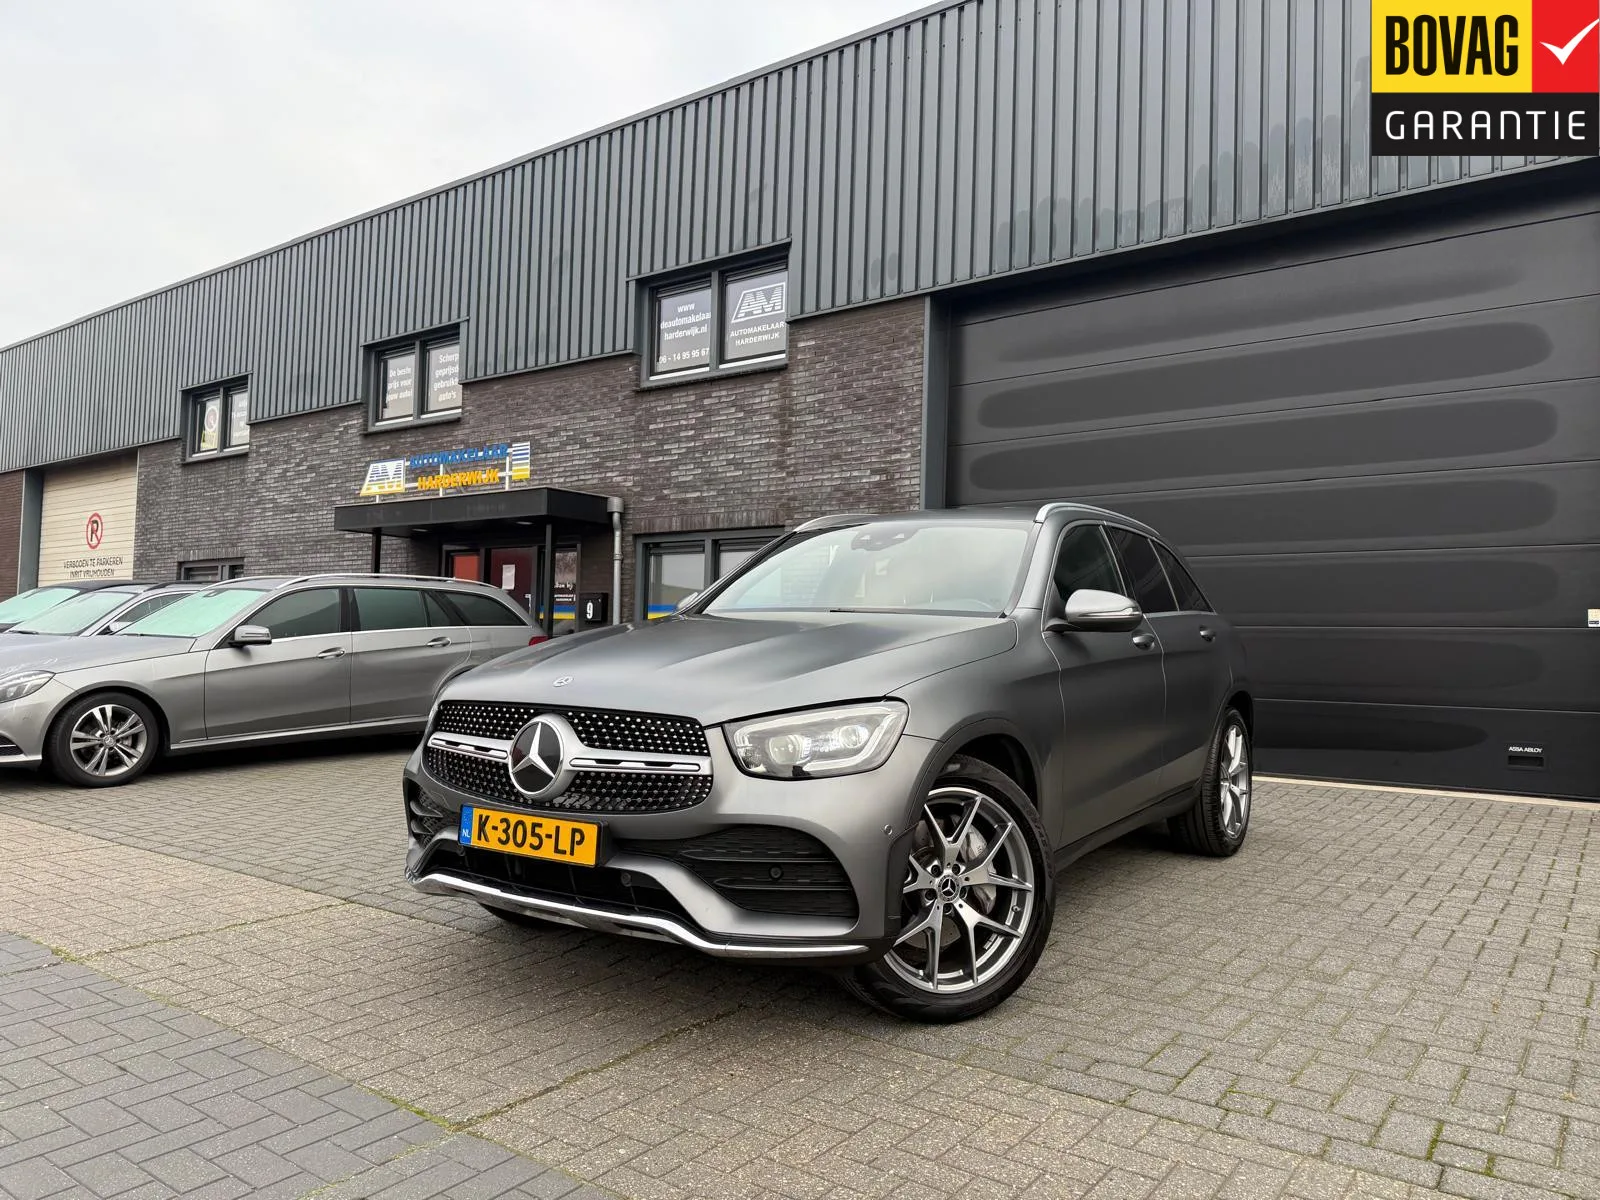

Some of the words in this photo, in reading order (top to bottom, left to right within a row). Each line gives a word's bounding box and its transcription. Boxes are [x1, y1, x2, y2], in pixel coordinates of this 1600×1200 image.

[664, 324, 708, 341] harderwijk.nl
[730, 321, 785, 338] AUTOMAKELAAR
[735, 332, 780, 347] HARDERWIJK
[673, 353, 681, 362] 14
[691, 349, 700, 358] 95
[409, 443, 509, 469] AUTOMAKELAAR
[417, 468, 500, 491] HARDERWIJK
[64, 559, 89, 569] VERBODEN
[90, 558, 96, 567] TE
[97, 556, 123, 567] PARKEREN
[586, 602, 594, 619] 9
[462, 829, 470, 838] NL
[477, 813, 586, 857] K-305-LP
